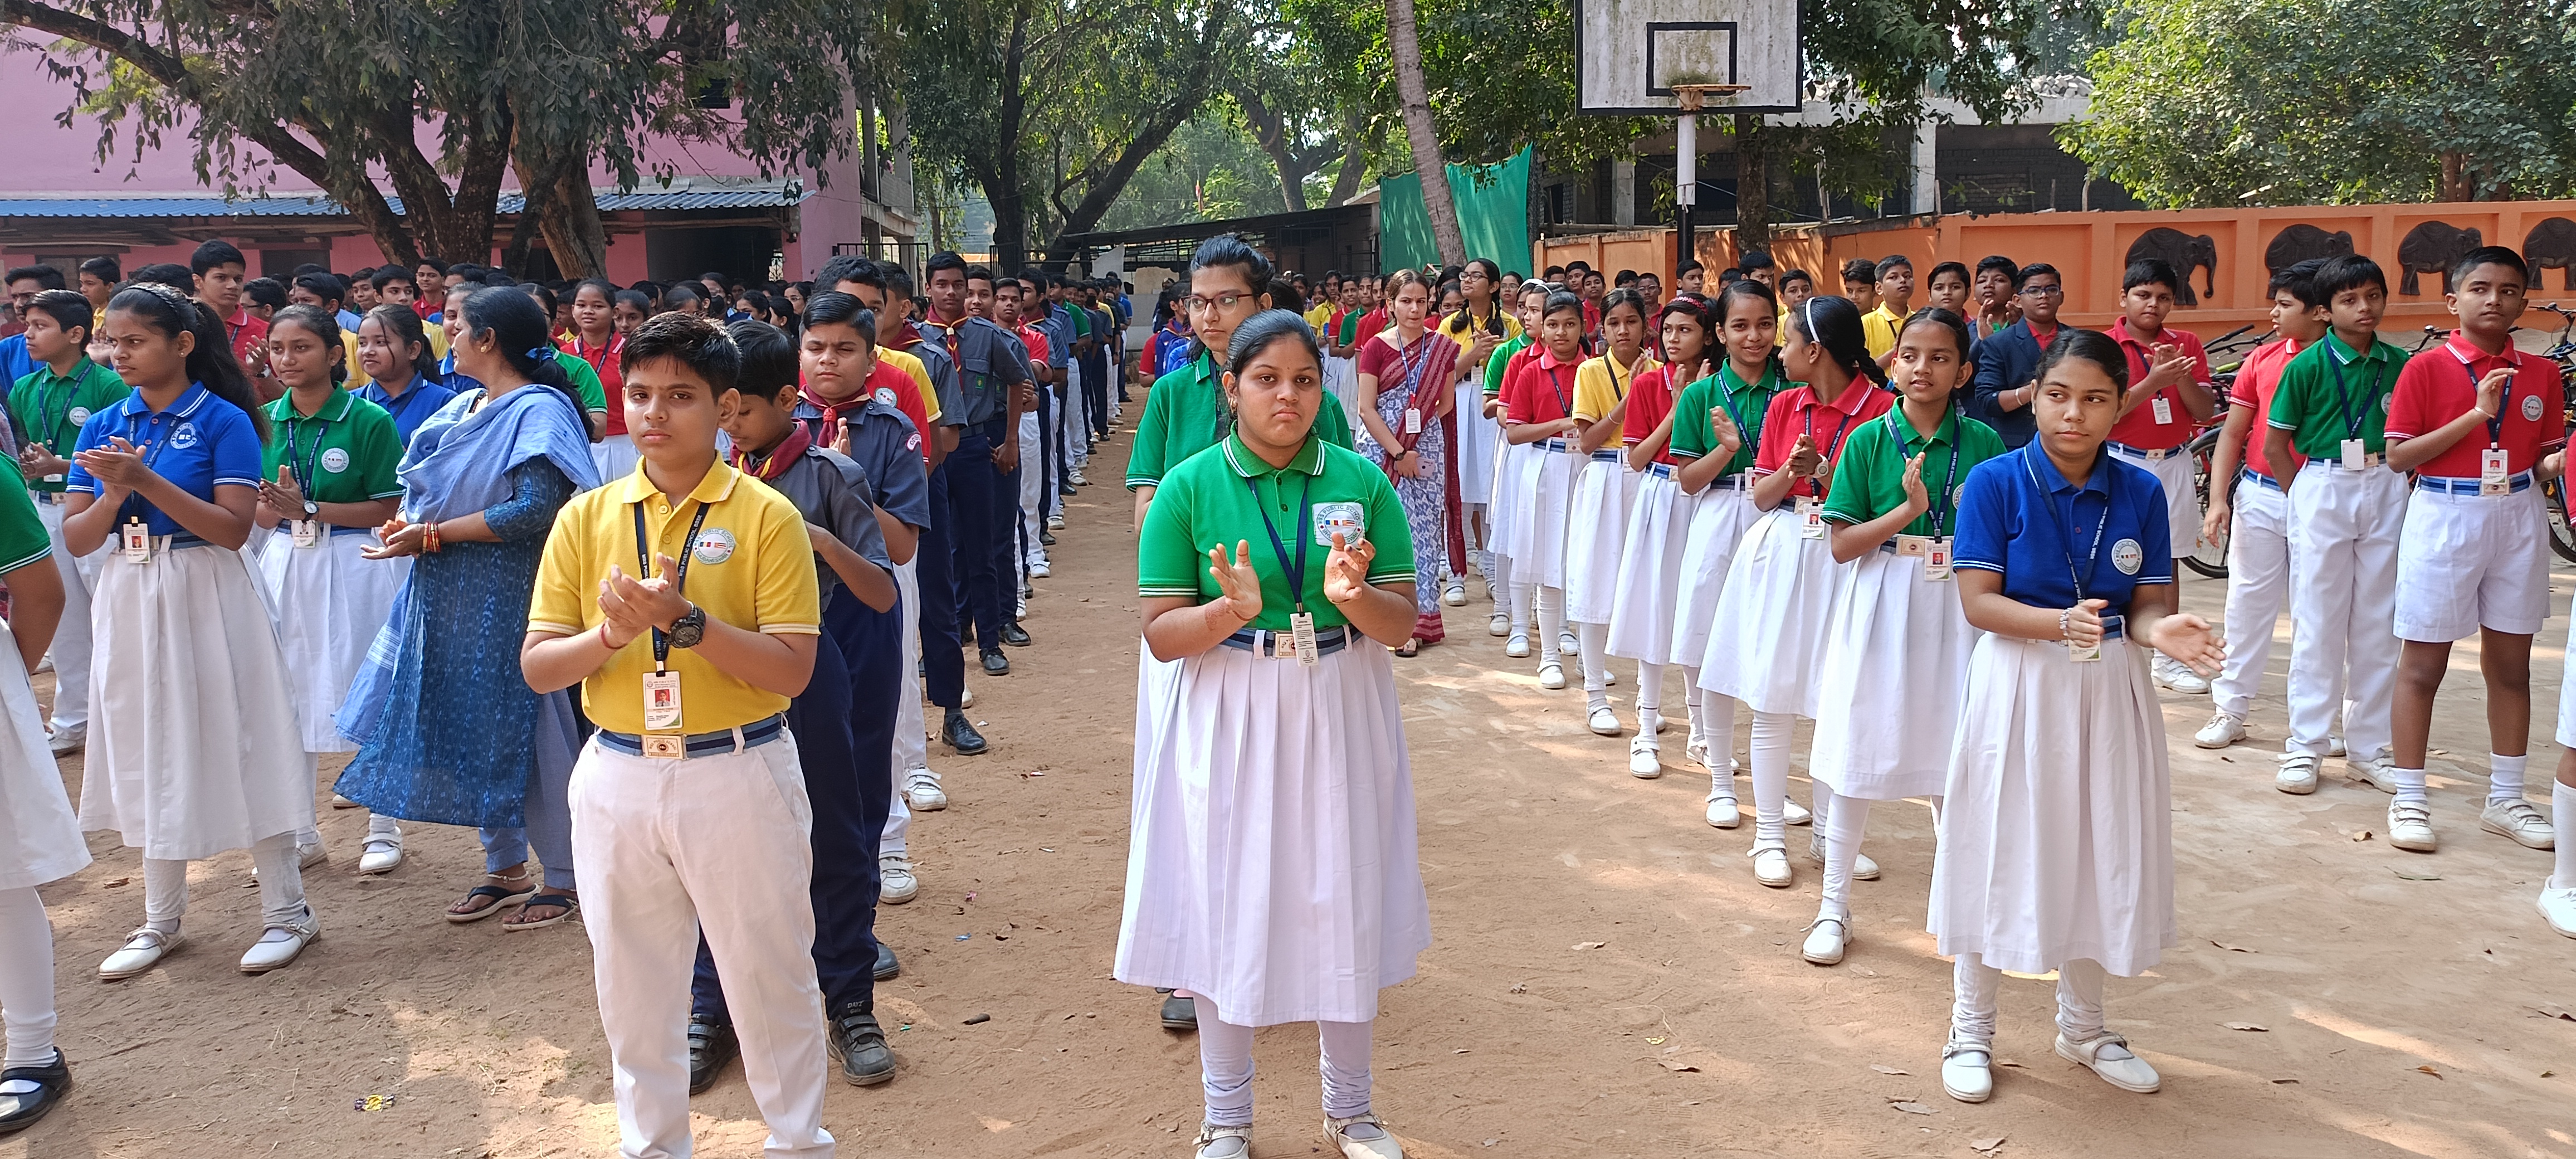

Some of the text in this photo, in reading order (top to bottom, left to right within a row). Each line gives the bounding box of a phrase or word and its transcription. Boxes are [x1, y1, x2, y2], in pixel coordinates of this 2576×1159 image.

[1323, 505, 1344, 514] PUBLIC
[681, 546, 690, 566] PUBLIC
[694, 514, 702, 528] BBSR
[721, 530, 734, 548] SCHOOL
[695, 551, 729, 563] BHUBANESWAR
